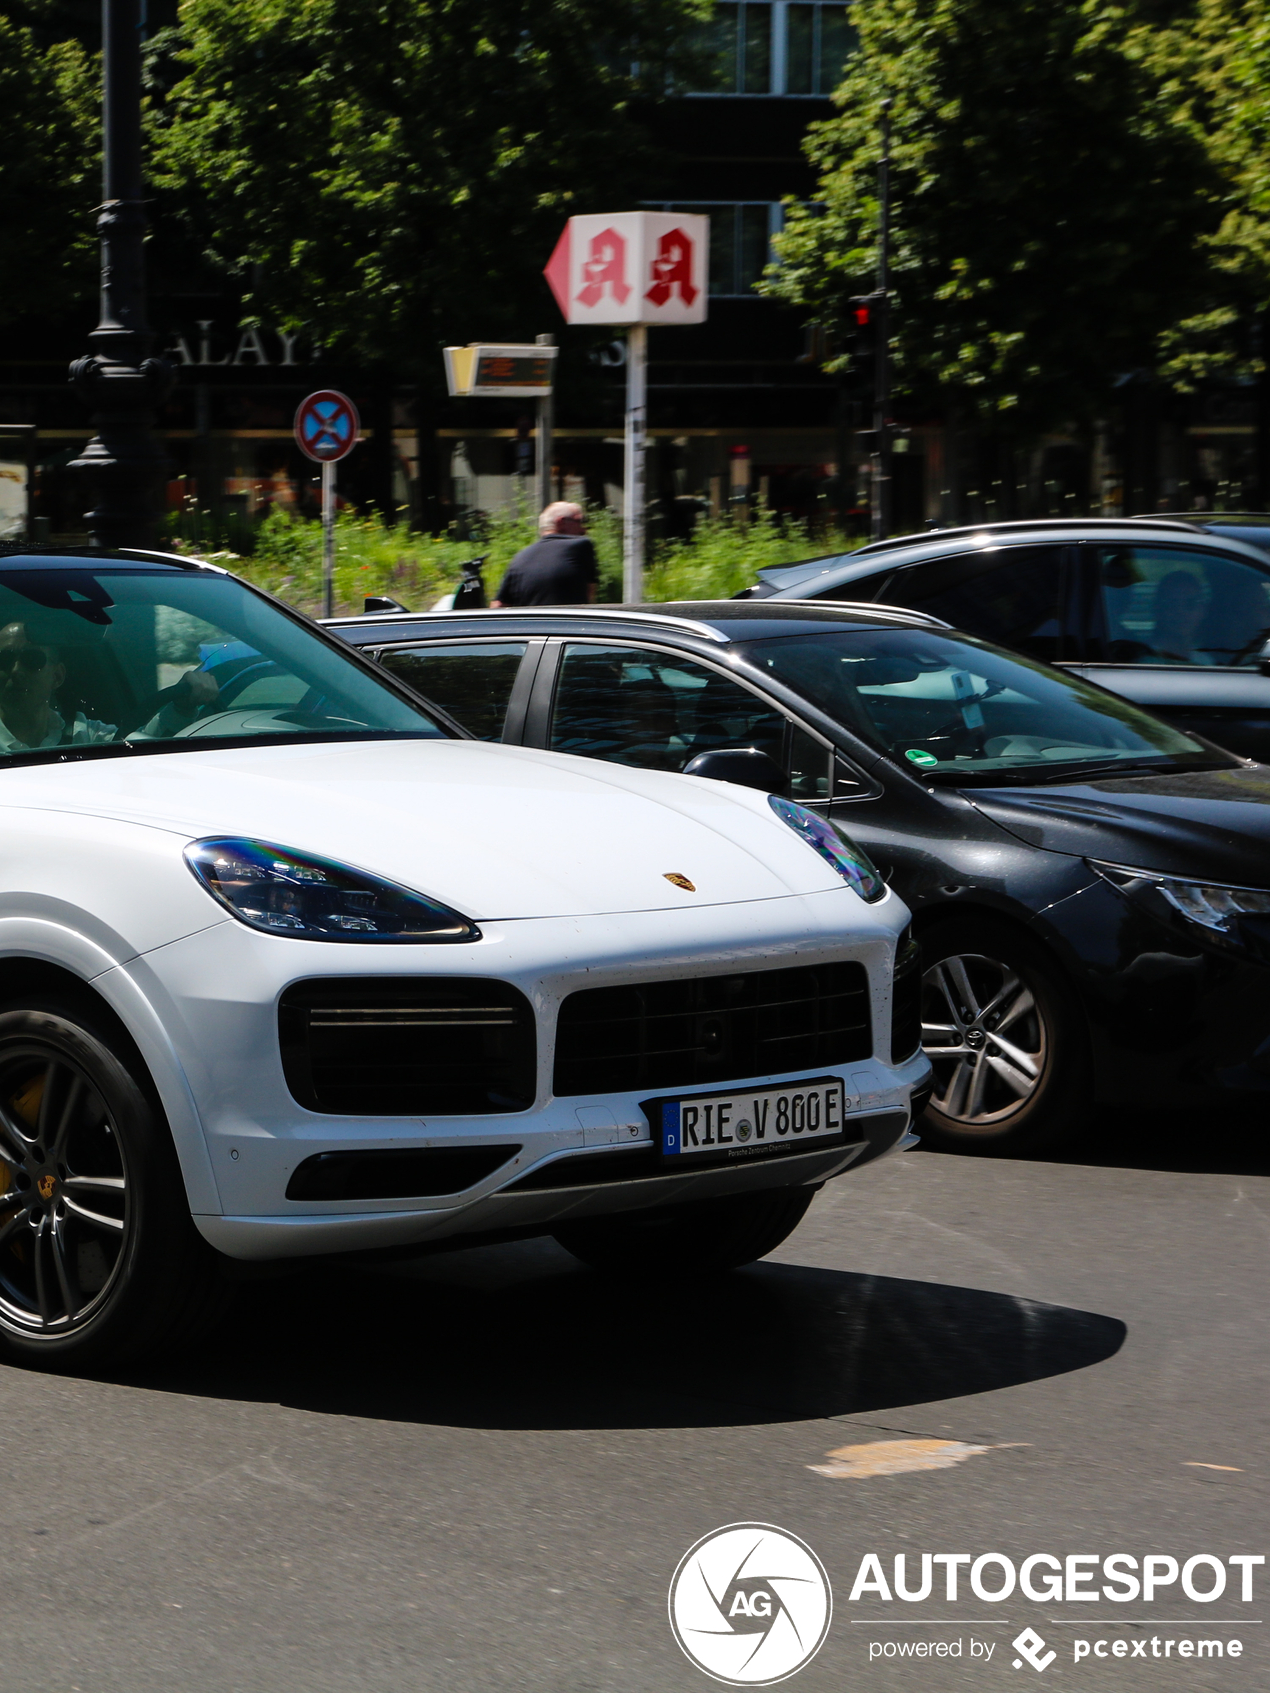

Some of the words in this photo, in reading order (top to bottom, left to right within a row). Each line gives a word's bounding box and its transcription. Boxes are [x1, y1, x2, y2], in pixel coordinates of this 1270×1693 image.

[682, 1102, 733, 1147] RIE
[754, 1098, 769, 1139] V
[667, 1134, 675, 1146] D
[728, 1149, 748, 1157] Porsche
[748, 1146, 768, 1155] Zentrum
[768, 1143, 791, 1152] Chemnitz
